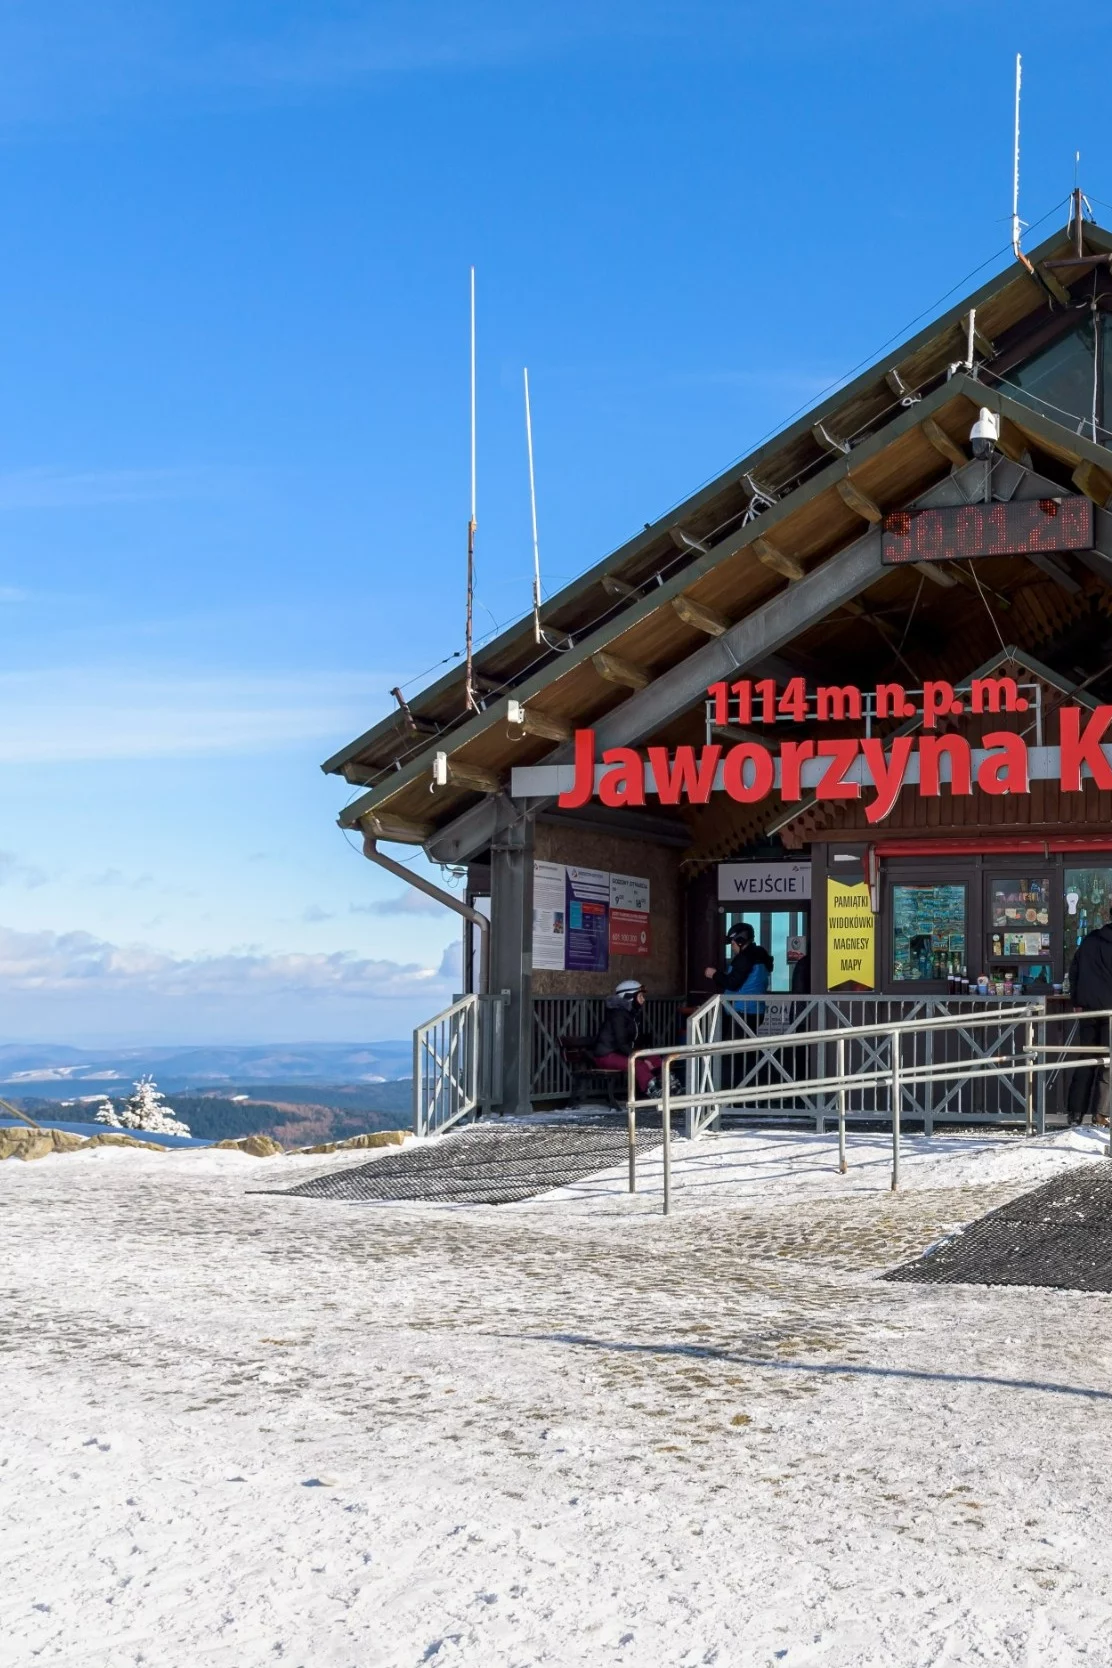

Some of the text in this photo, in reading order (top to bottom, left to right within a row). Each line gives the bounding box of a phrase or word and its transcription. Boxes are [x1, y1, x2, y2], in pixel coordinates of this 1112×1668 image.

[708, 677, 808, 727] 1114
[816, 684, 862, 721] m
[558, 729, 1029, 824] Jaworzyna
[734, 874, 797, 893] WEJŚCIE
[834, 895, 869, 909] PAMIĄTKI
[829, 915, 873, 928] WIDOKÓWKI
[833, 937, 869, 950] MAGNESY
[840, 958, 862, 971] MAPY
